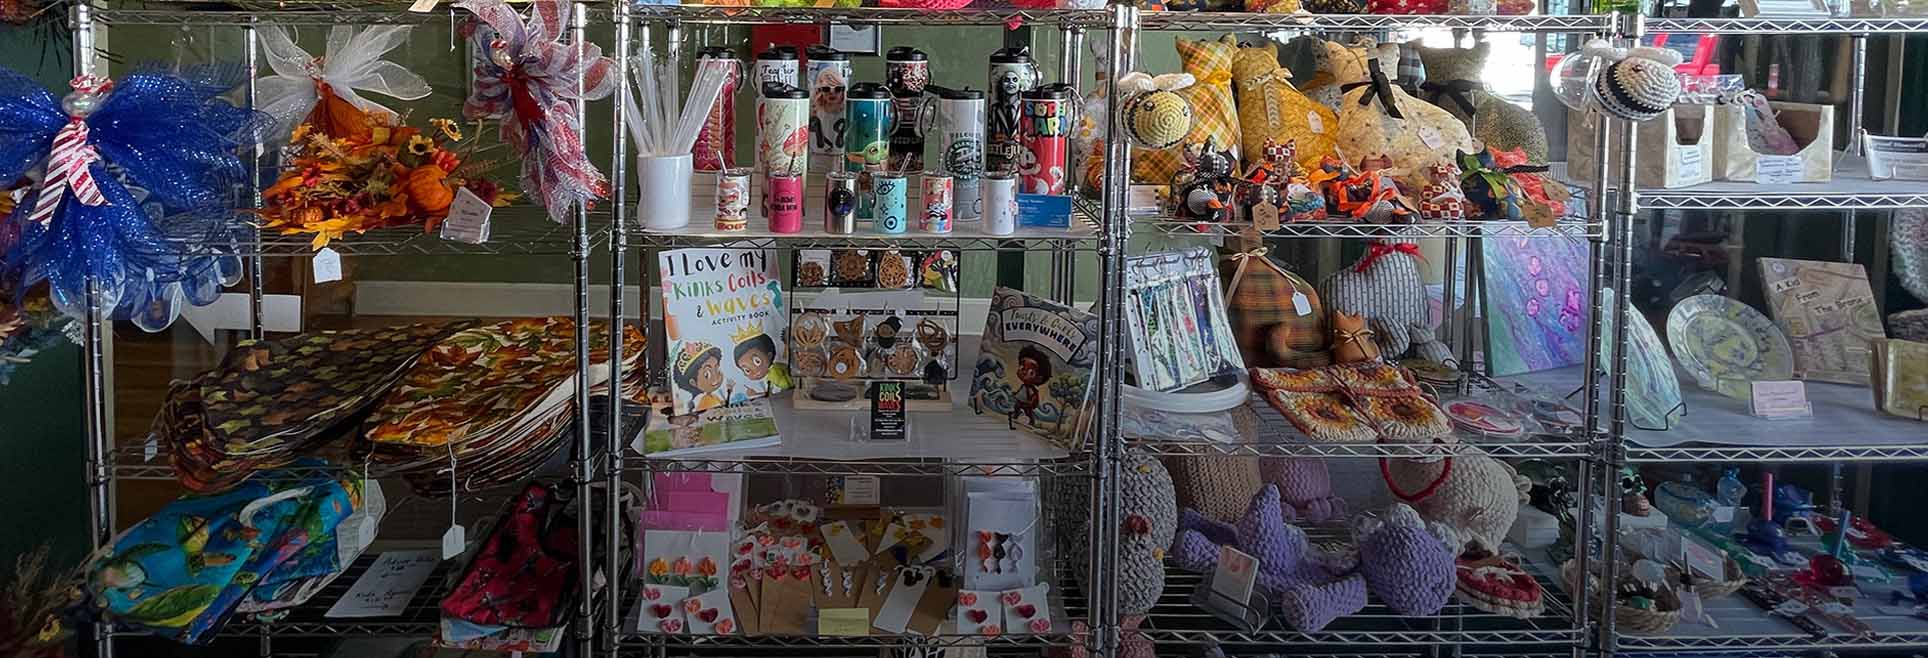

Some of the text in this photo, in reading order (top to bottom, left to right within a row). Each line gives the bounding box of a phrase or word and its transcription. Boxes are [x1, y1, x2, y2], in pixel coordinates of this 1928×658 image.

[665, 255, 674, 277] I
[740, 248, 767, 273] my
[673, 270, 767, 300] Kinks Coils
[696, 304, 704, 318] &
[711, 311, 769, 326] ACTIVITY BOOK
[1005, 321, 1077, 353] EVERYWHERE
[879, 391, 902, 401] COILS
